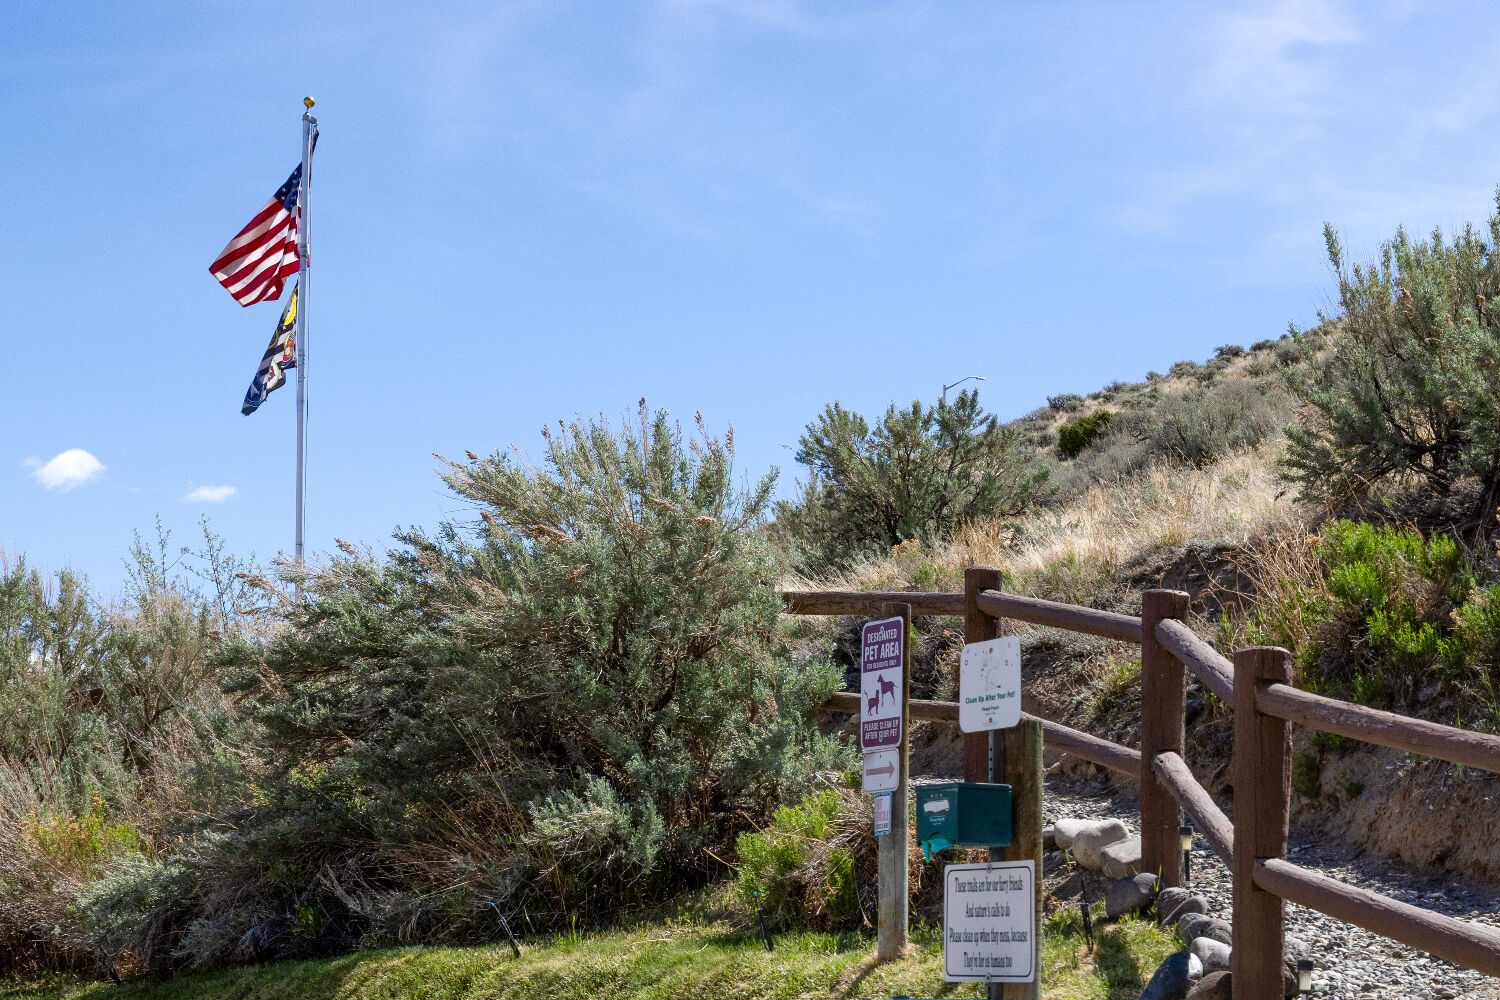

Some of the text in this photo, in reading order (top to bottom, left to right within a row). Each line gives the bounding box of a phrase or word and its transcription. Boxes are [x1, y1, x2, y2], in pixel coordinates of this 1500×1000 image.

[867, 629, 897, 643] DESIGNATED
[865, 641, 899, 661] PET AREA
[978, 695, 984, 703] Up
[864, 719, 899, 731] PLEASE CLEAN UP
[865, 731, 878, 740] AFTER
[890, 728, 898, 737] PET
[955, 876, 966, 892] These
[967, 876, 977, 892] trails
[999, 875, 1008, 894] furry
[1009, 875, 1023, 891] friends
[965, 902, 974, 917] And
[975, 902, 990, 917] nature's
[1005, 902, 1010, 917] do
[949, 927, 961, 942] Please
[963, 927, 973, 942] clean
[974, 932, 978, 946] up
[980, 927, 990, 942] when
[991, 927, 999, 945] they
[1011, 926, 1027, 942] because
[963, 951, 977, 971] They're
[991, 953, 1005, 968] humans
